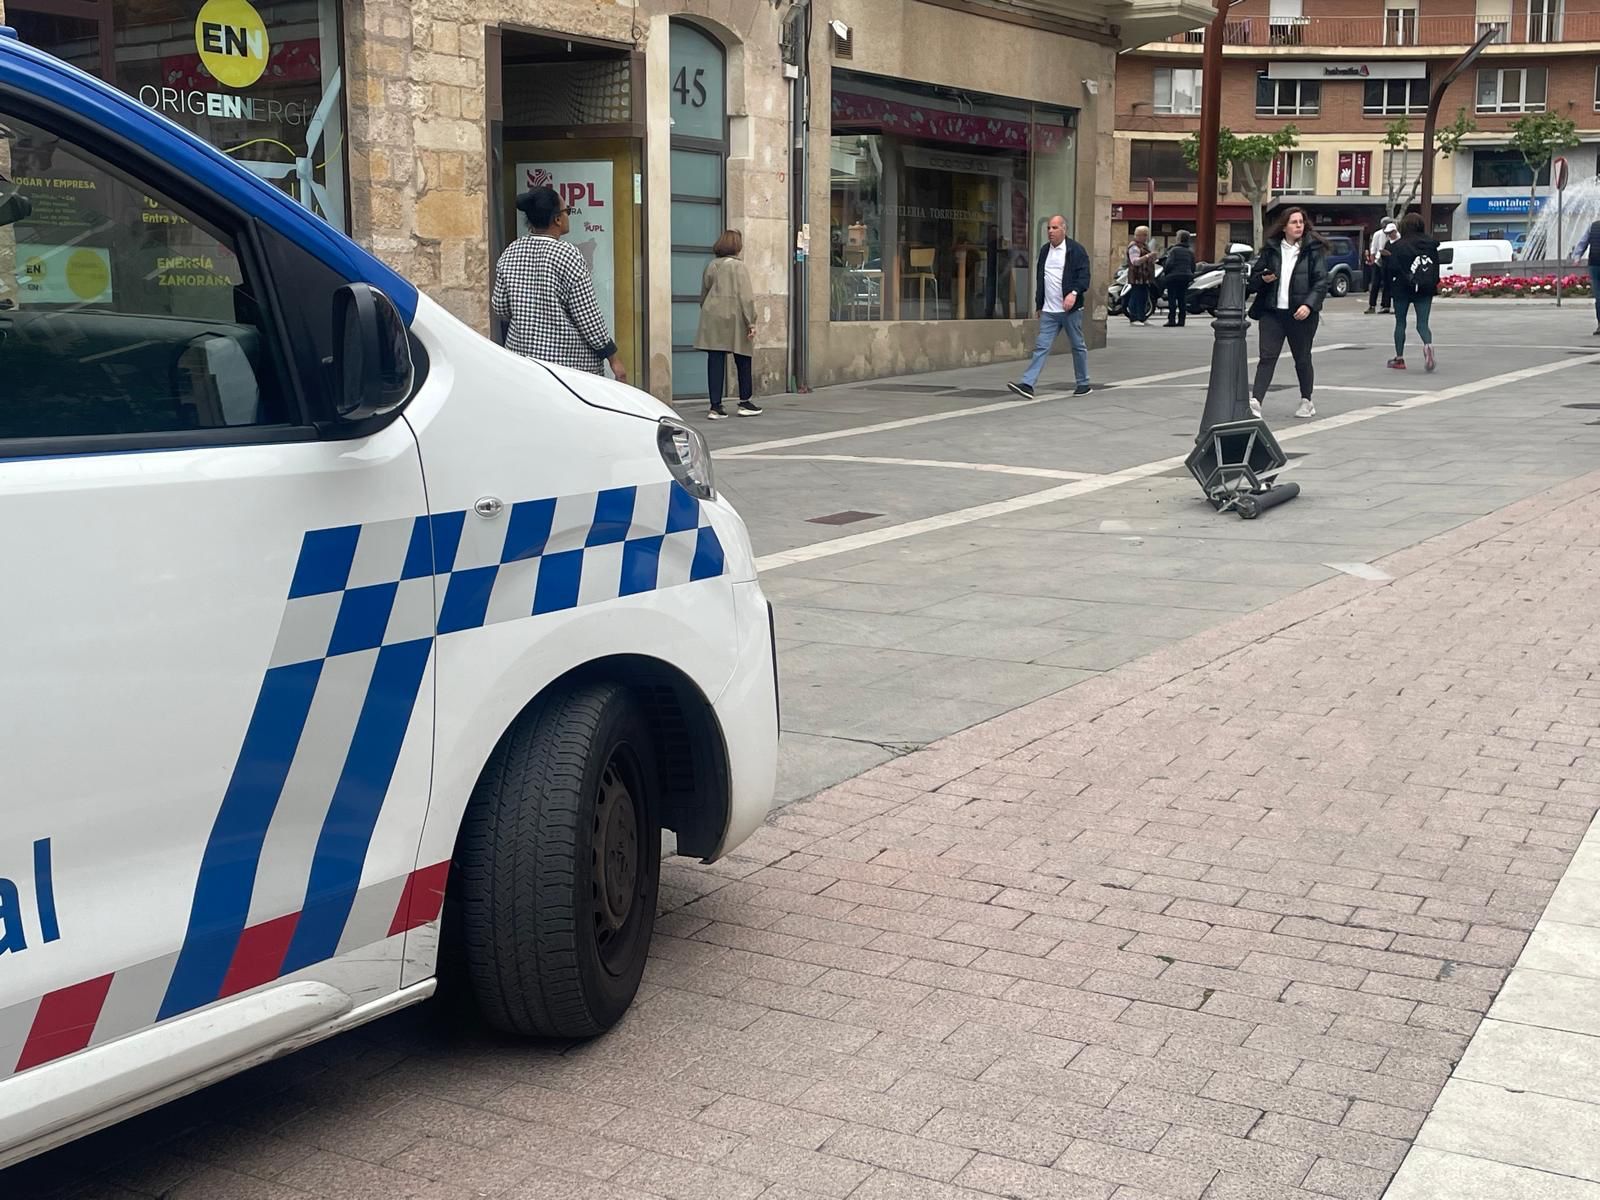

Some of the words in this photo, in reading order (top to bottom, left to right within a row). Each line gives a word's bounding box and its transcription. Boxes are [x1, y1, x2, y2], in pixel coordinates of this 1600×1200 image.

[672, 66, 707, 108] 45
[46, 179, 52, 187] Y
[53, 179, 96, 190] EMPRESA
[1487, 198, 1540, 207] santaluca
[142, 213, 169, 223] Entra
[156, 254, 214, 270] ENERGÍA
[158, 274, 233, 287] ZAMORANA
